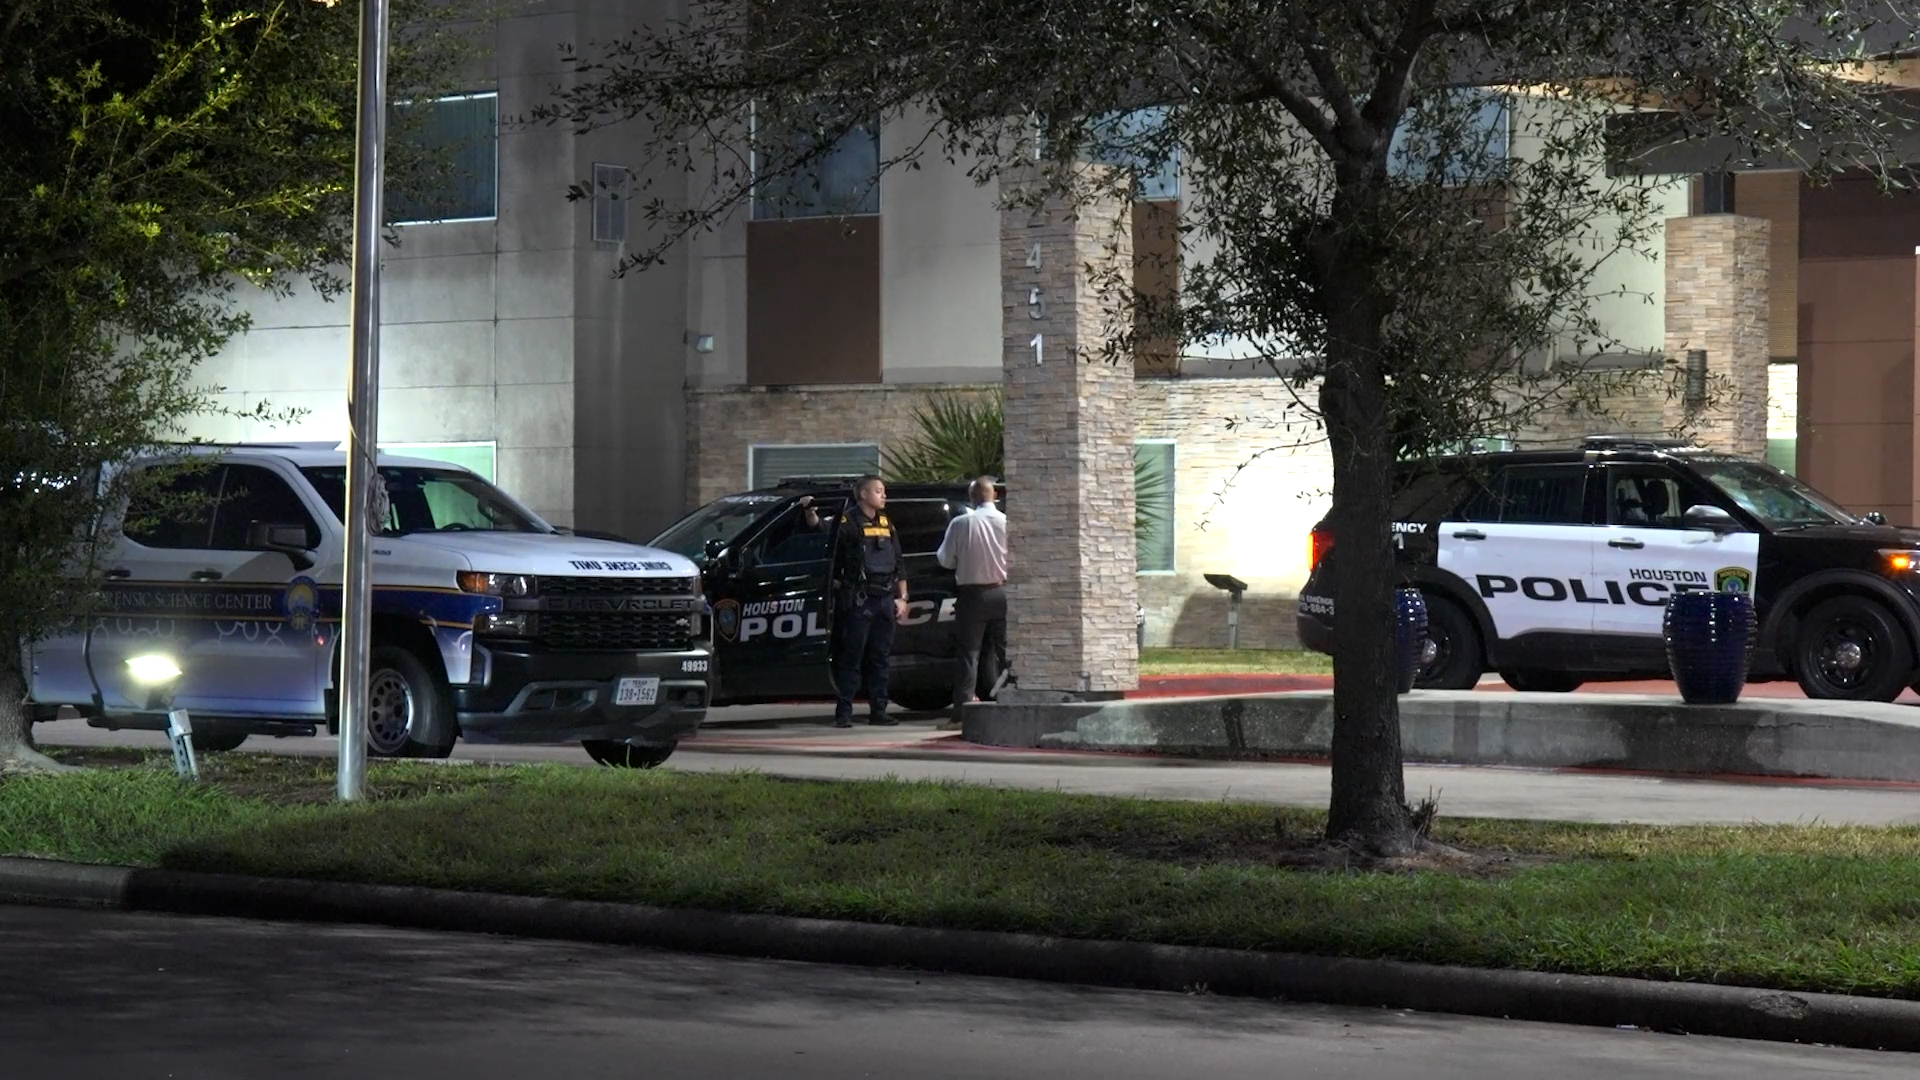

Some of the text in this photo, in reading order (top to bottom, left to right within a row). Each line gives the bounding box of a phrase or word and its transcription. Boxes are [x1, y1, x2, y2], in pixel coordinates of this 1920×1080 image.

[1629, 568, 1707, 582] HOUSTON
[155, 593, 211, 609] SCIENCE
[214, 594, 273, 610] CENTER
[547, 598, 696, 611] CHEVROLET
[742, 598, 806, 617] HOUSTON
[681, 660, 708, 672] 49933
